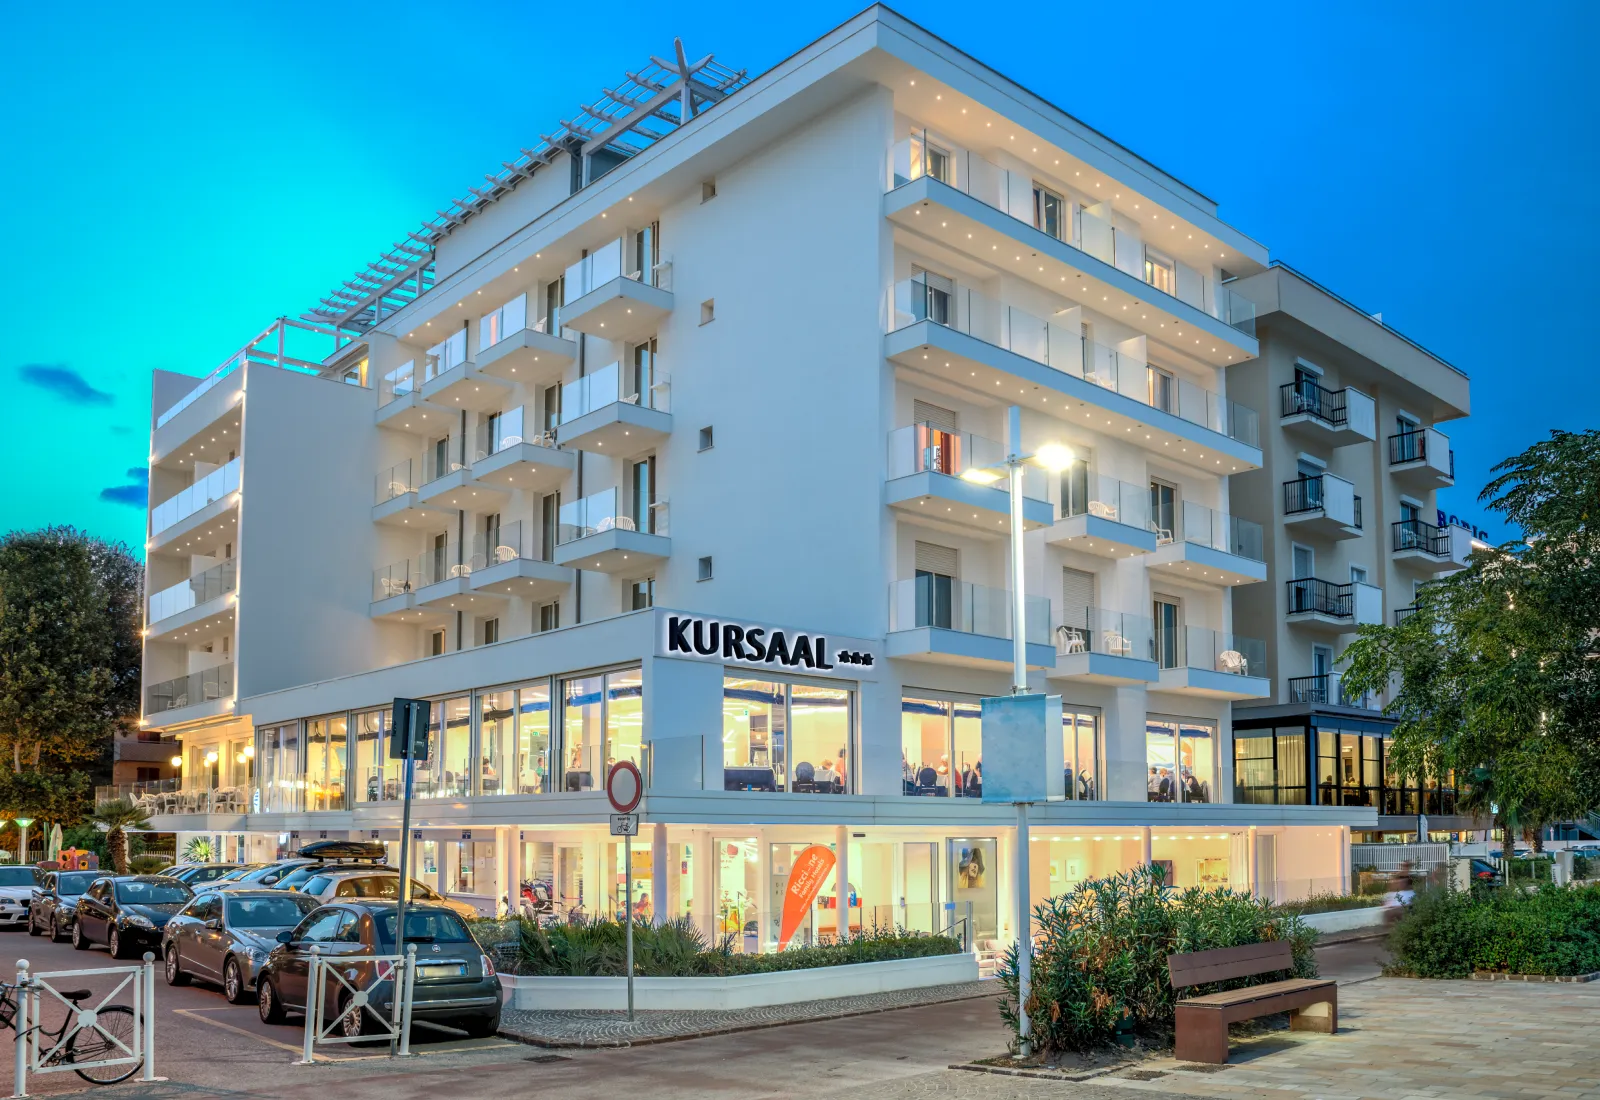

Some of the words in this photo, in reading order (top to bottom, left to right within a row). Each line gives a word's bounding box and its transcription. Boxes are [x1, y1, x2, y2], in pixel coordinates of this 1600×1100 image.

[668, 616, 833, 670] KURSAAL
[799, 878, 814, 899] Family
[810, 858, 825, 879] Hotels
